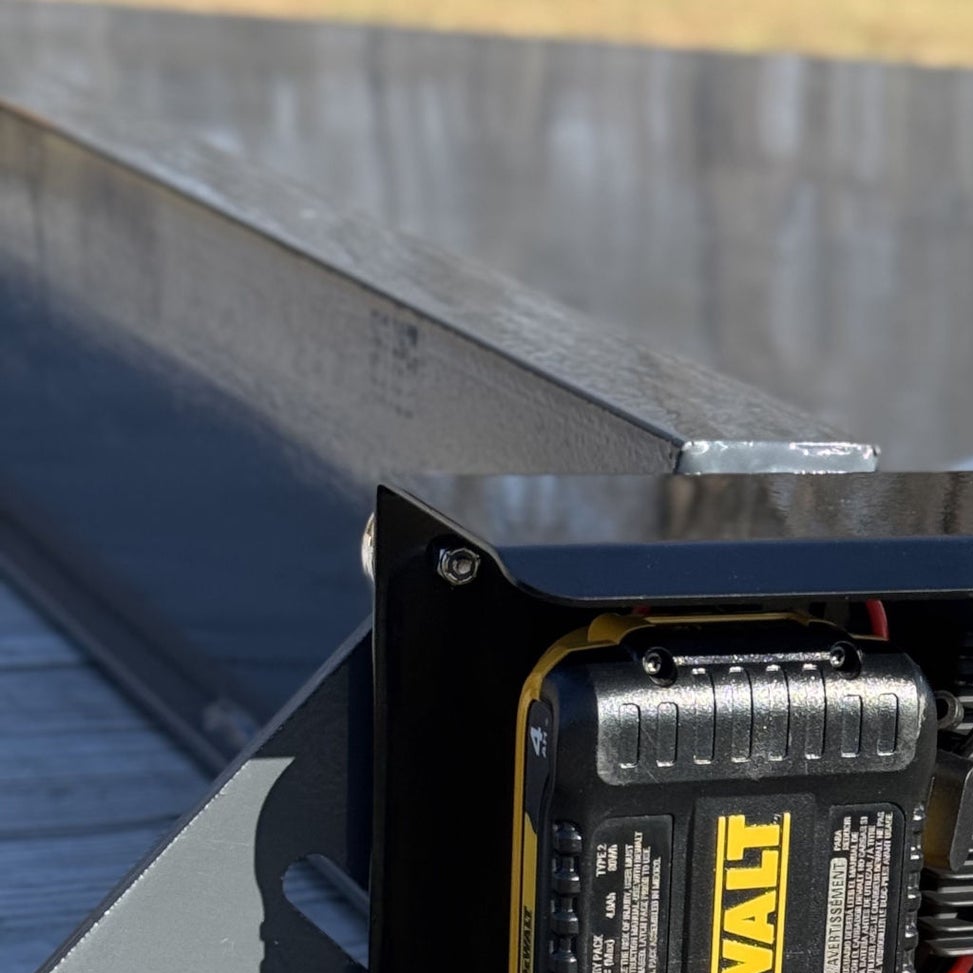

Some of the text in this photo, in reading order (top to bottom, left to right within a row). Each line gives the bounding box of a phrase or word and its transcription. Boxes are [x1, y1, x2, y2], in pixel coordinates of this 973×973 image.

[529, 726, 543, 757] 4
[595, 852, 607, 877] TYPE
[624, 843, 633, 867] MUST
[622, 921, 630, 931] OF
[826, 862, 845, 966] AVERTISSEMENT
[592, 934, 604, 961] PACK
[603, 939, 615, 966] (Max)
